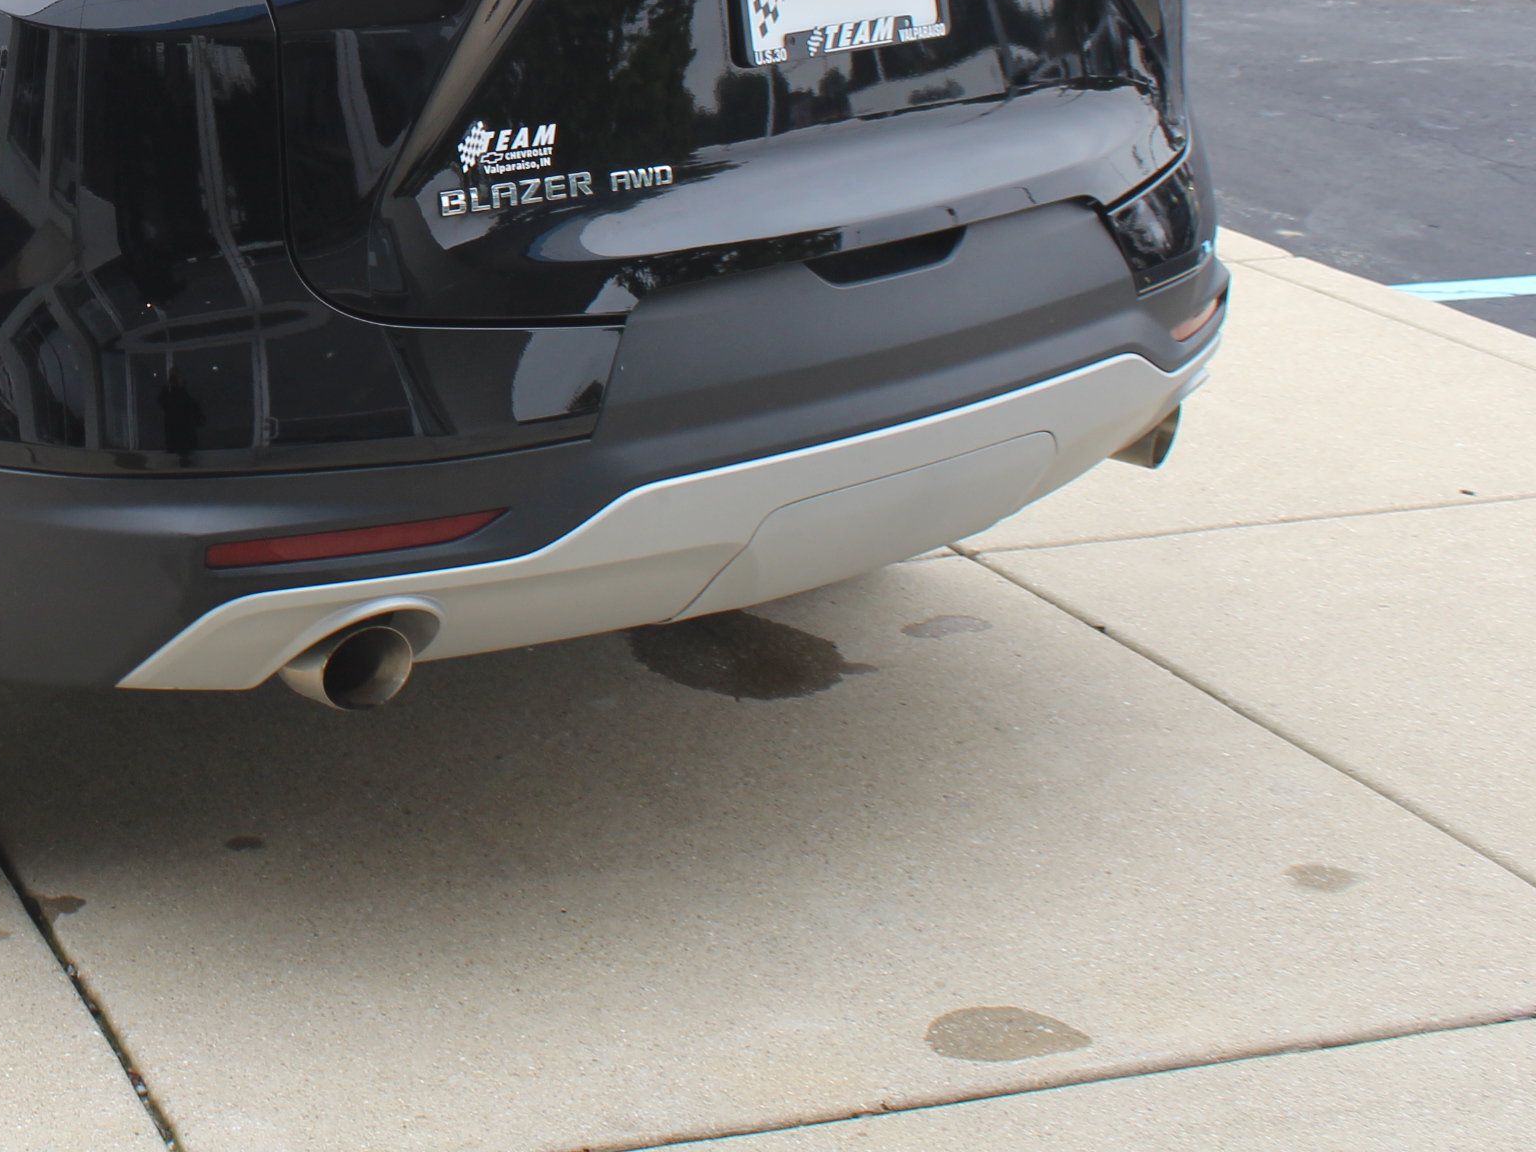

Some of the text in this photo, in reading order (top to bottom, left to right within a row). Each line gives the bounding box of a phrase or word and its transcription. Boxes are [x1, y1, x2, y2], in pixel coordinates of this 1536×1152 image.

[823, 16, 896, 51] TEAM
[898, 22, 947, 42] VALPARAISO
[481, 124, 557, 153] TEAM
[504, 146, 553, 161] CHEVROLET
[439, 165, 674, 217] BLAZER AWD
